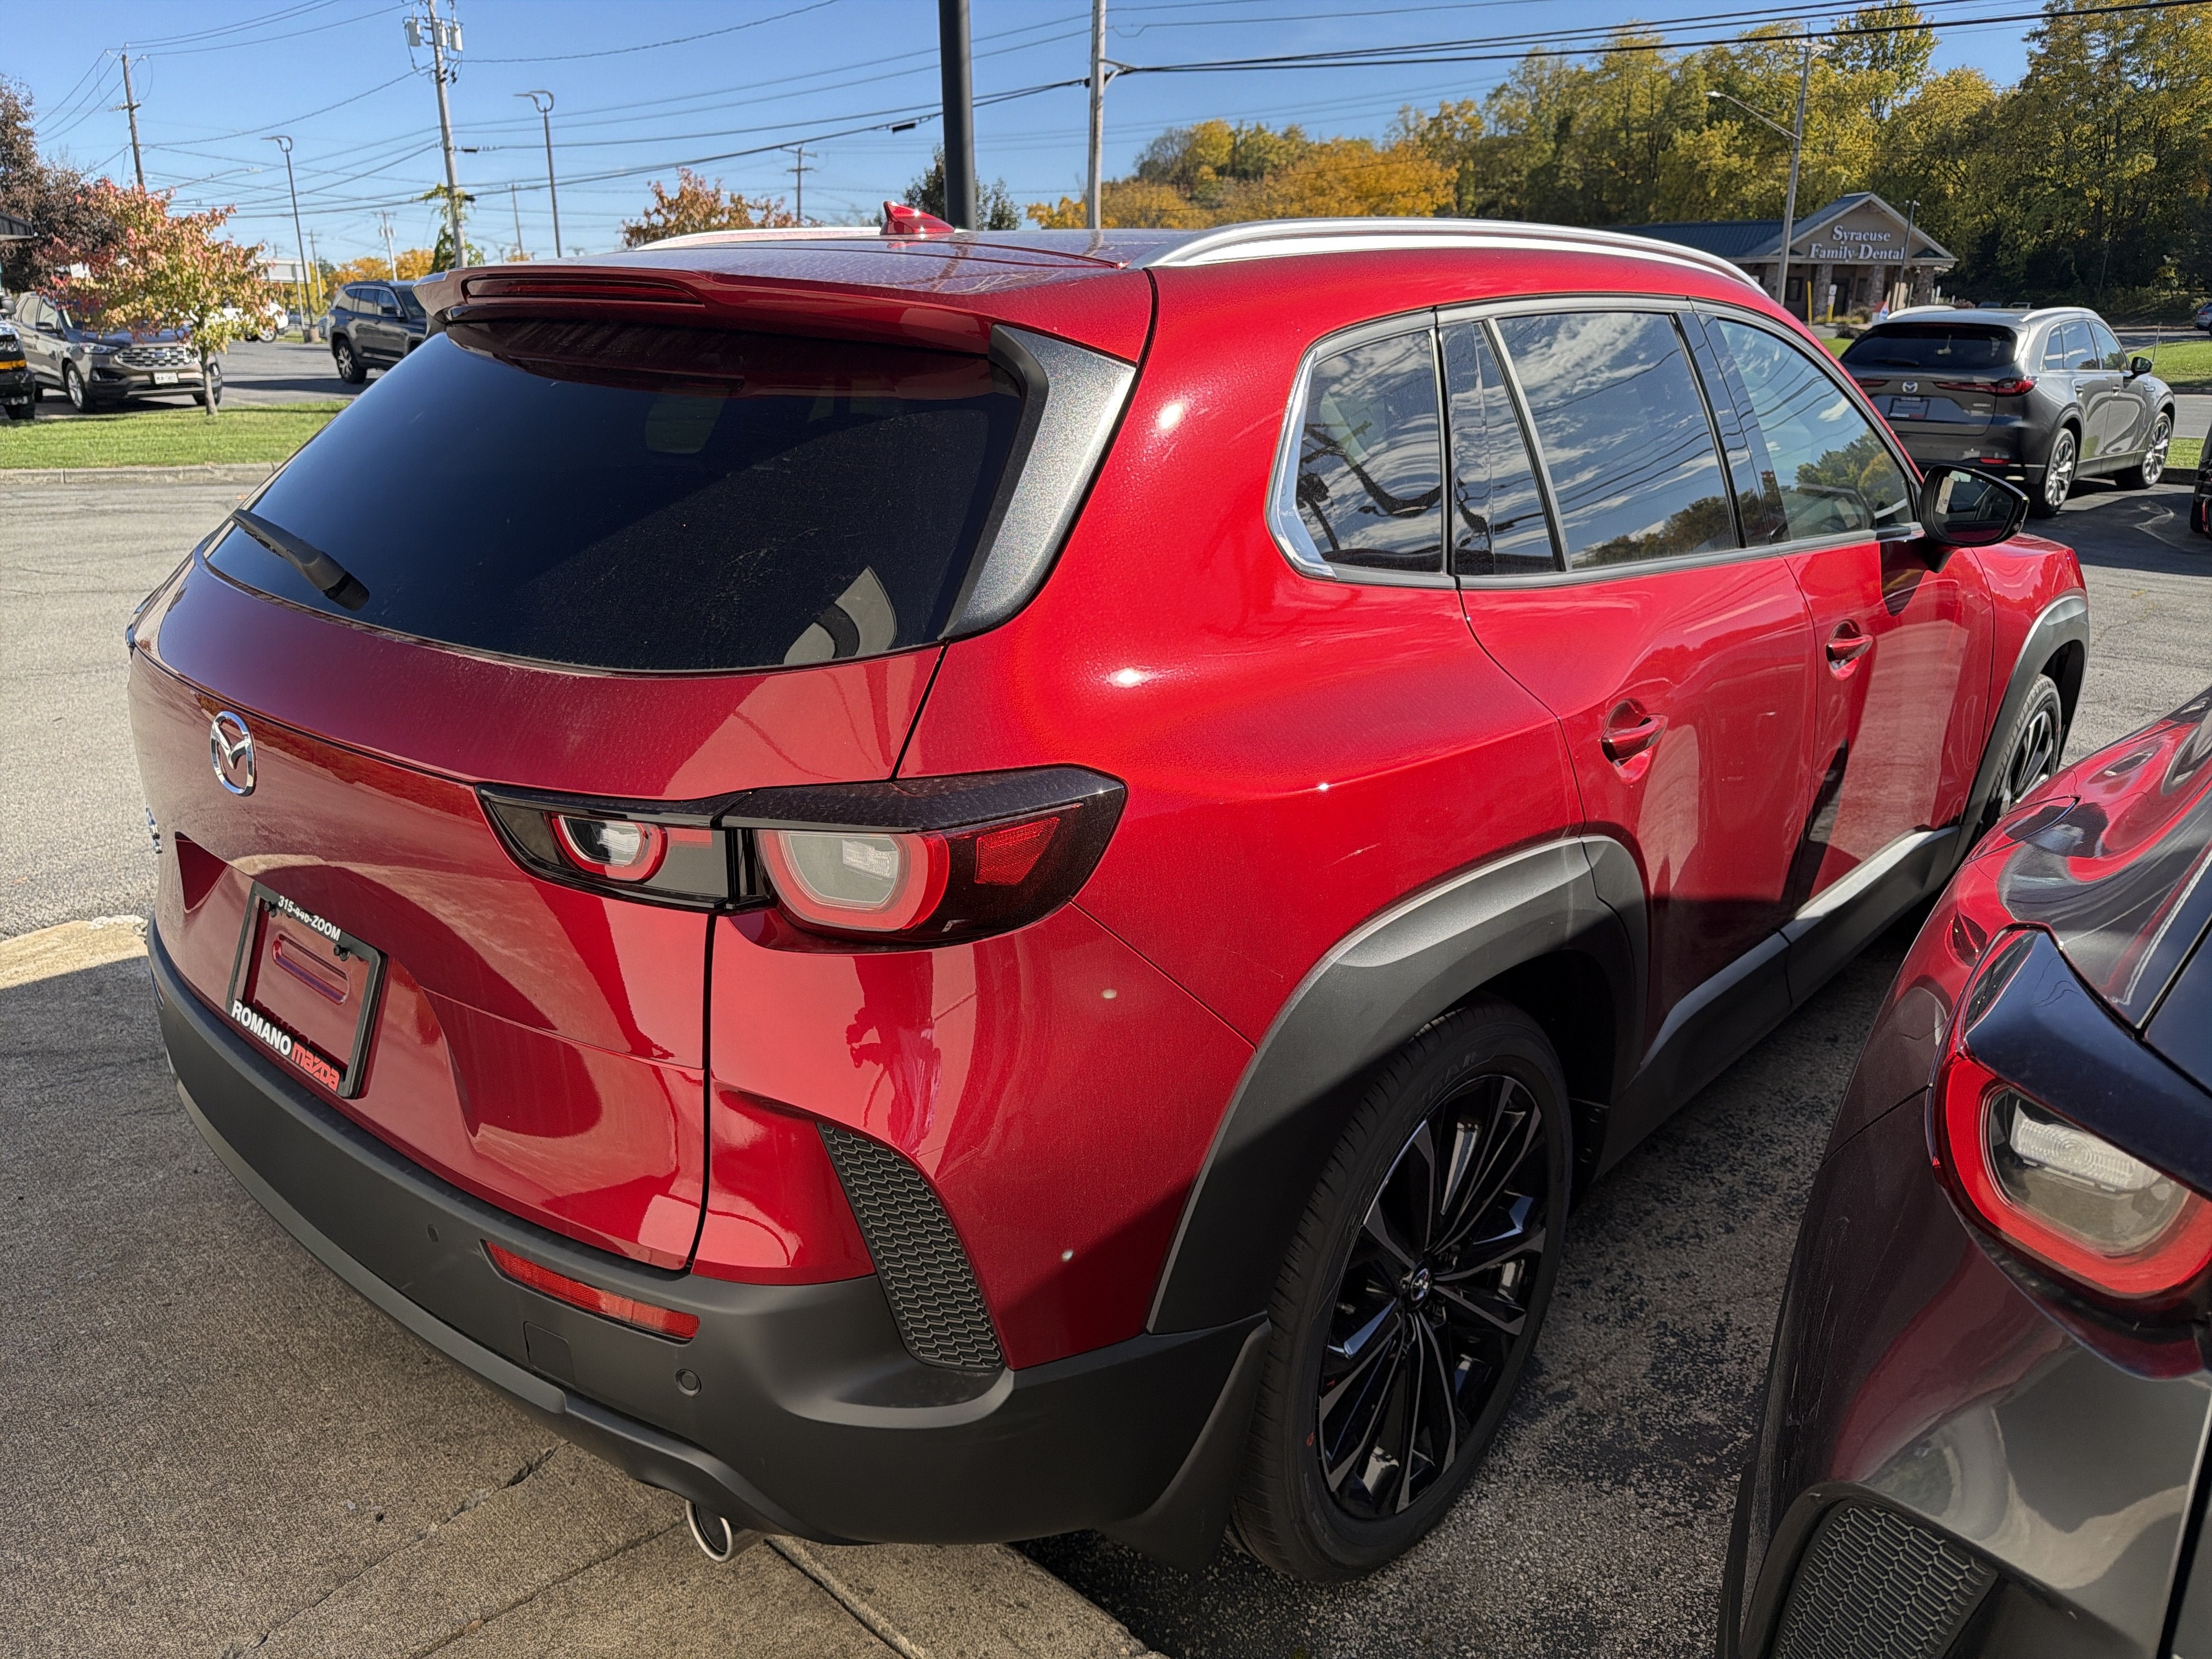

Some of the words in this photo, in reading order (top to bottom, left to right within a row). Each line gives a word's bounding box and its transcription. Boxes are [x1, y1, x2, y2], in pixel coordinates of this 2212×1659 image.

[1832, 225, 1891, 244] Syracuse
[1809, 243, 1853, 263] Family
[1858, 244, 1905, 260] Dental
[231, 1000, 291, 1056] ROMANO
